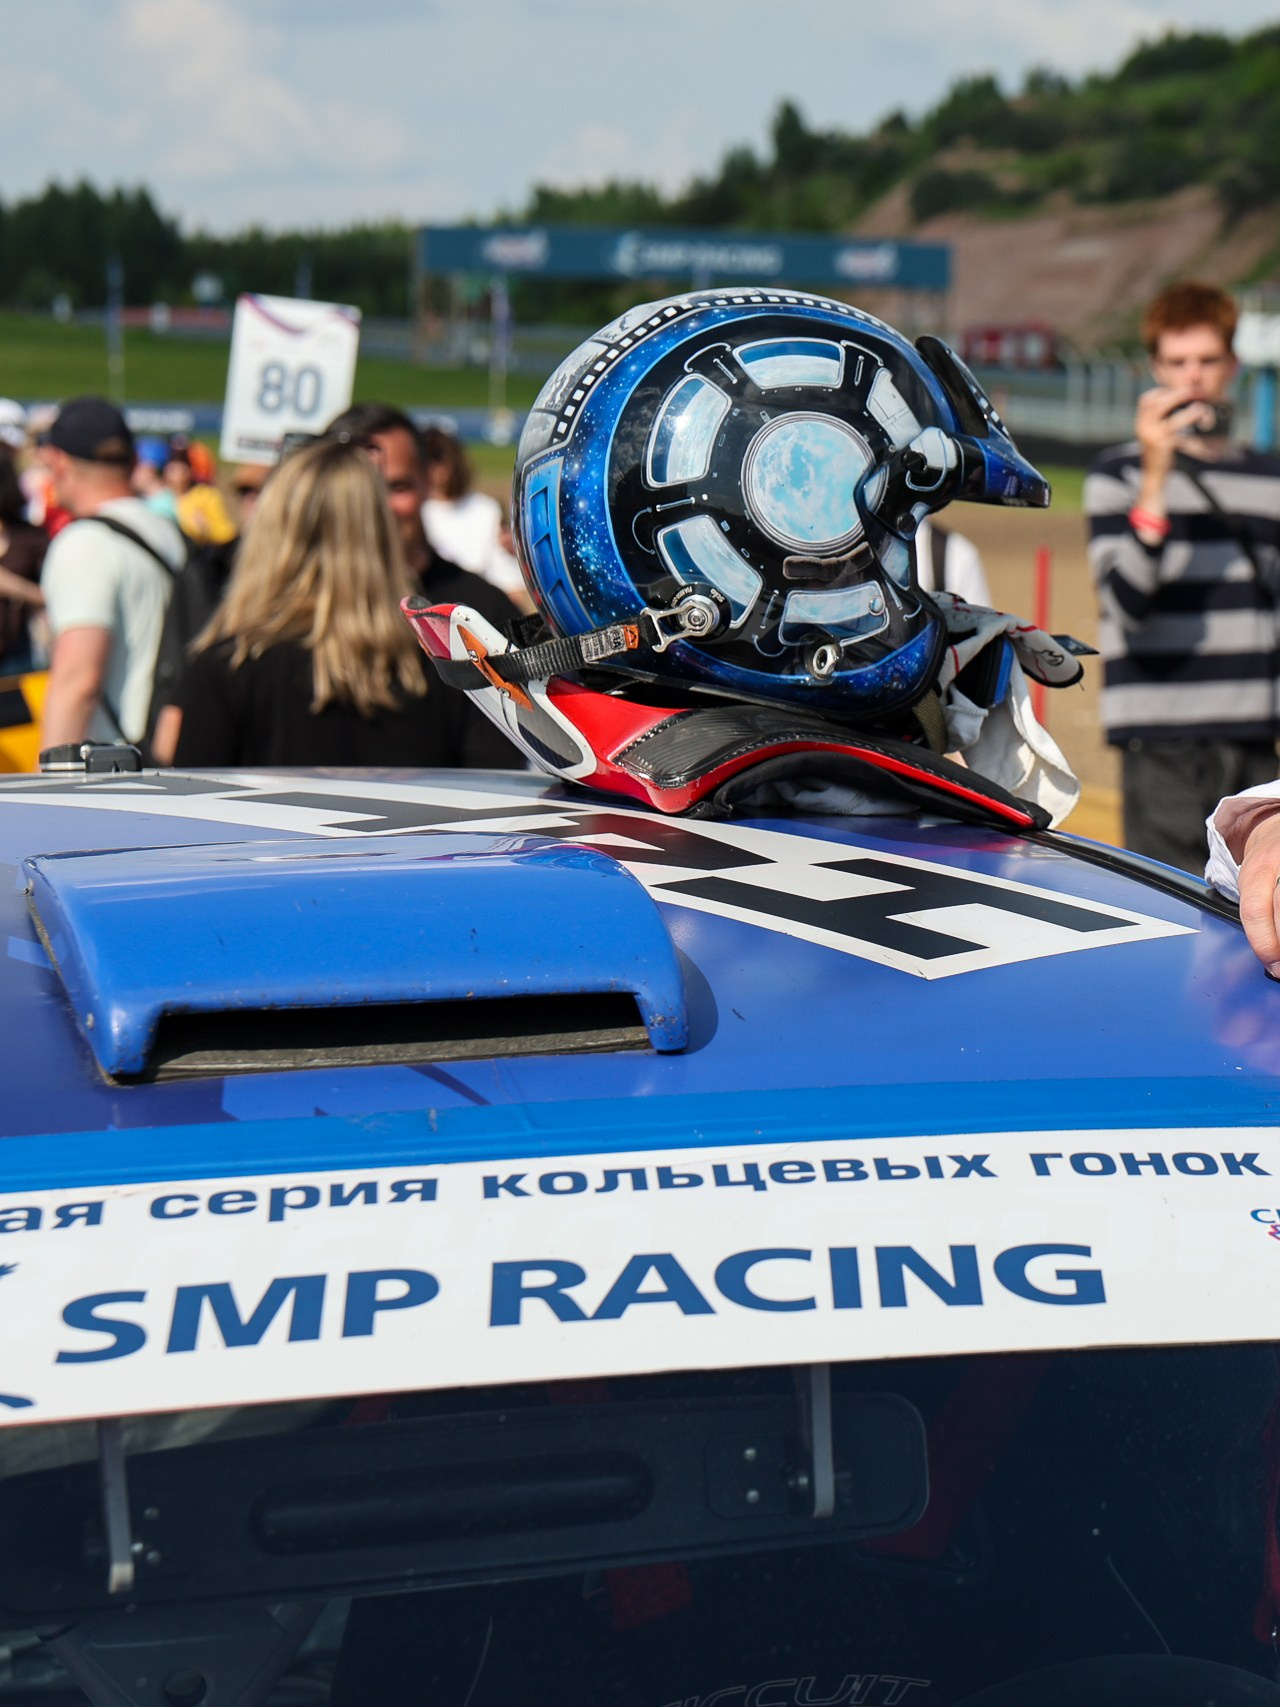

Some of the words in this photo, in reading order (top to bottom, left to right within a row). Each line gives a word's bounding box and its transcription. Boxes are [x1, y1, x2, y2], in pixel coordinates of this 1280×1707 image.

[257, 358, 323, 417] 80
[150, 1178, 439, 1223] серия
[483, 1156, 997, 1201] кольцевых
[1031, 1153, 1270, 1178] гонок
[55, 1269, 442, 1365] SMP
[490, 1244, 1108, 1328] RACING
